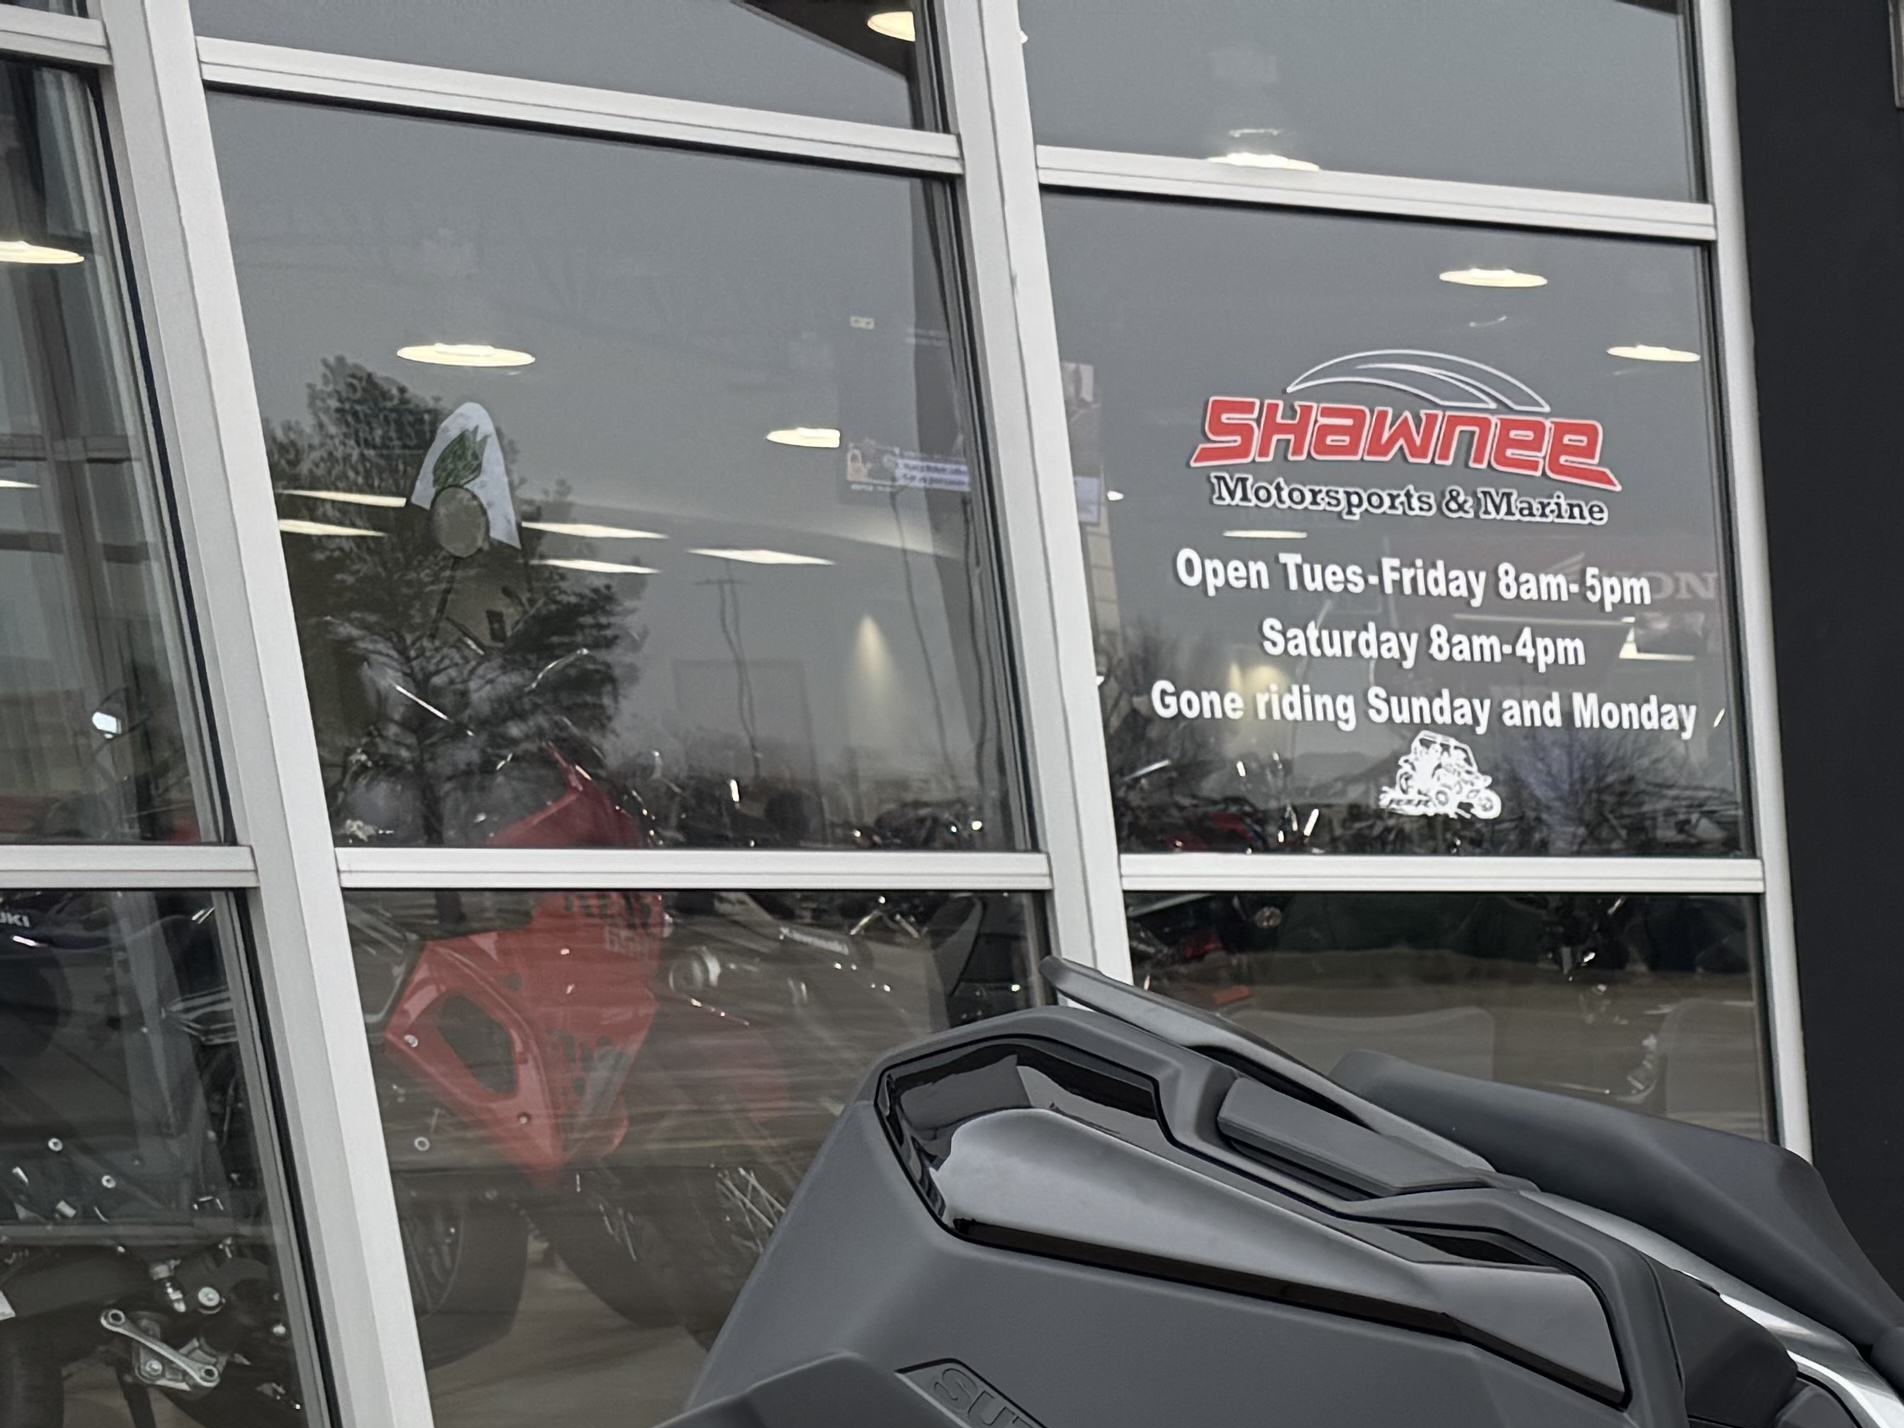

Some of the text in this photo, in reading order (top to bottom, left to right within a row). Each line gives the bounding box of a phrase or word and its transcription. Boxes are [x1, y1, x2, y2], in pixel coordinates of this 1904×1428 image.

[1211, 473, 1608, 525] Motorsports & Marine
[1175, 548, 1270, 595] Open
[1278, 551, 1486, 607] Tues-Friday
[1262, 618, 1586, 673] Saturday 8am-4pm
[1150, 680, 1696, 740] Gone riding Sunday and Monday
